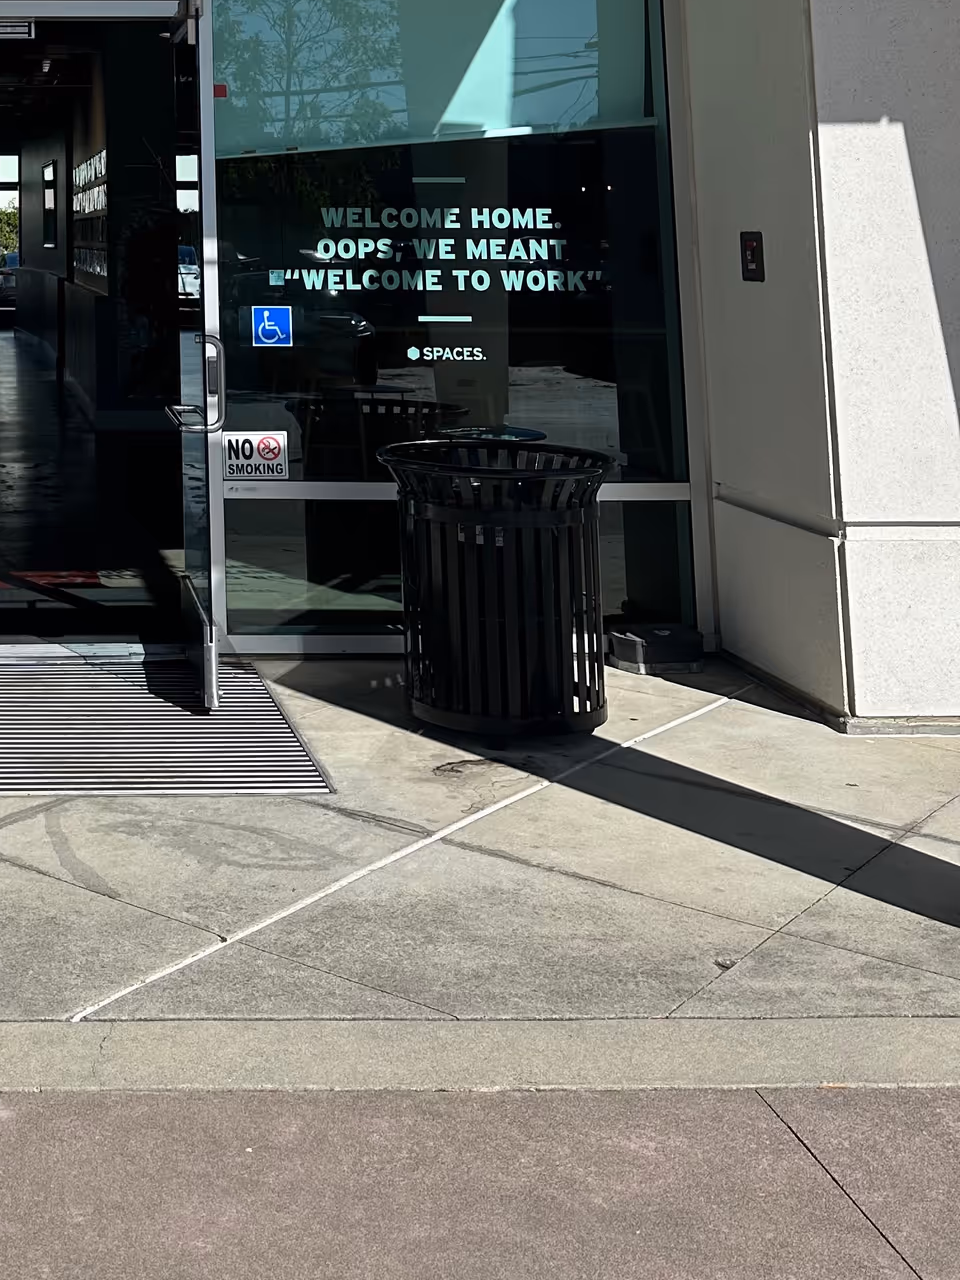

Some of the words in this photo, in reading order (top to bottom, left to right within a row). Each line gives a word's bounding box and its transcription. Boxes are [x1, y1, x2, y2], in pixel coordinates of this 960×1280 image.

[321, 207, 461, 229] WELCOME
[470, 207, 562, 229] HOME.
[317, 238, 402, 262] OOPS,
[412, 238, 456, 260] WE
[465, 238, 567, 260] MEANT
[452, 270, 491, 291] TO
[422, 346, 487, 361] SPACES.
[227, 438, 254, 461] NO
[228, 463, 284, 475] SMOKING
